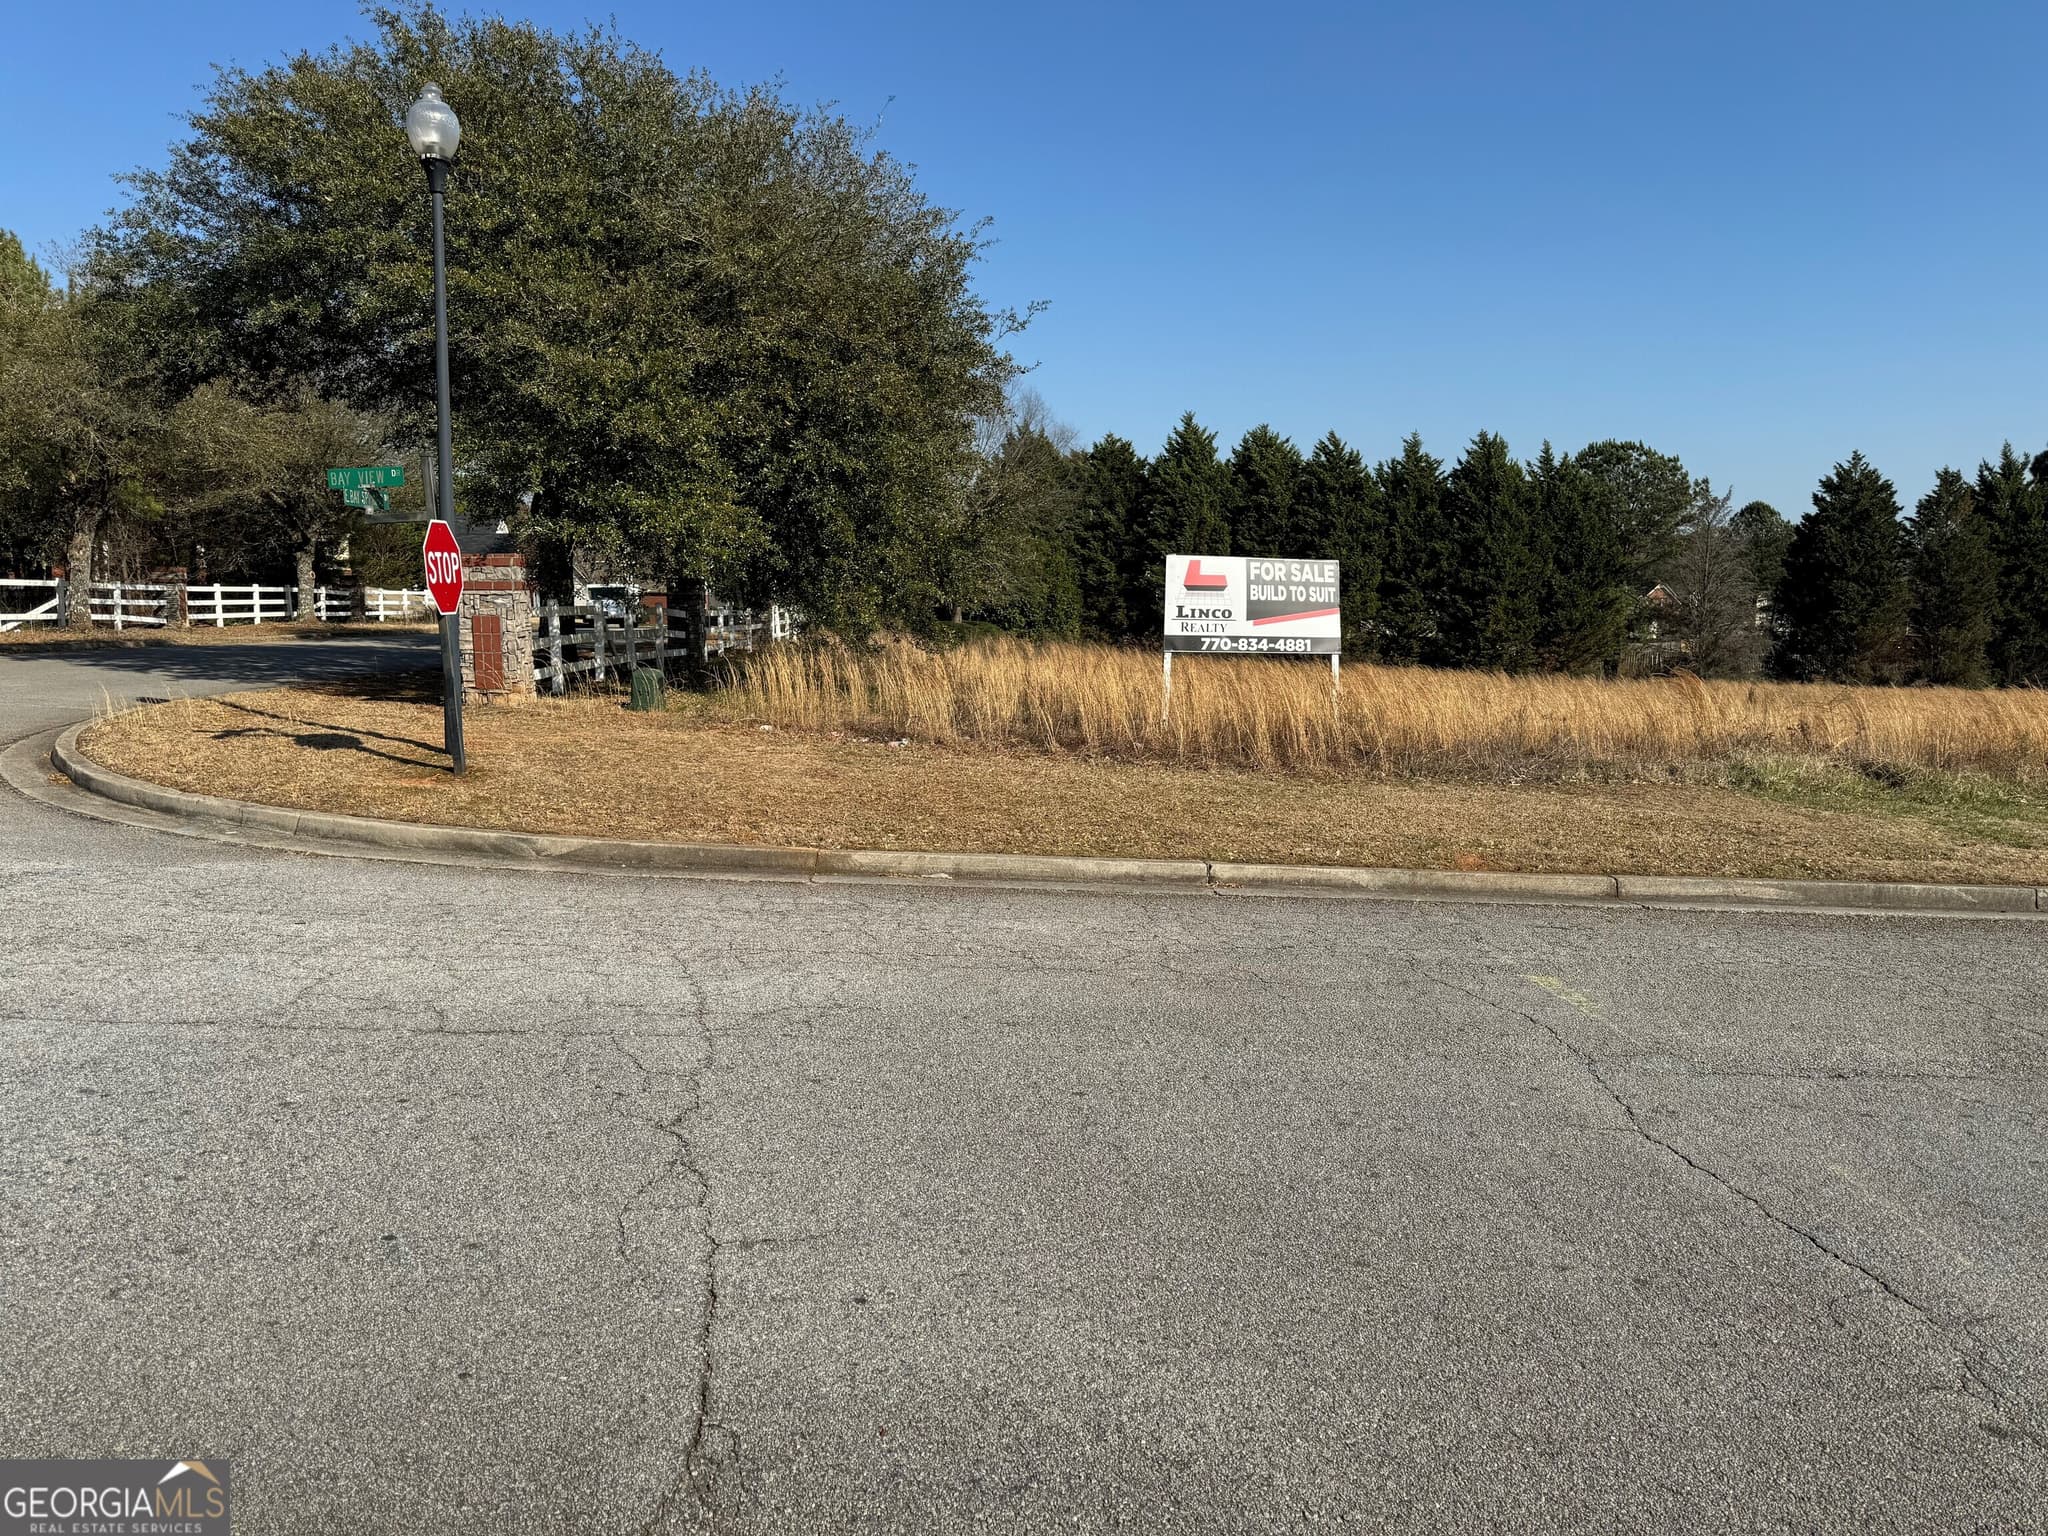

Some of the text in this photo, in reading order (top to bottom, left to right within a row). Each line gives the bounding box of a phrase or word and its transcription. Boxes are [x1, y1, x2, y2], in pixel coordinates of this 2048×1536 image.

[330, 471, 350, 486] BAY
[358, 470, 384, 484] VIEW
[350, 490, 360, 504] BAY
[428, 551, 459, 584] STOP
[1250, 562, 1335, 583] FOR SALE
[1250, 585, 1336, 603] BUILD TO SUIT
[1201, 638, 1312, 651] 770-834-4881
